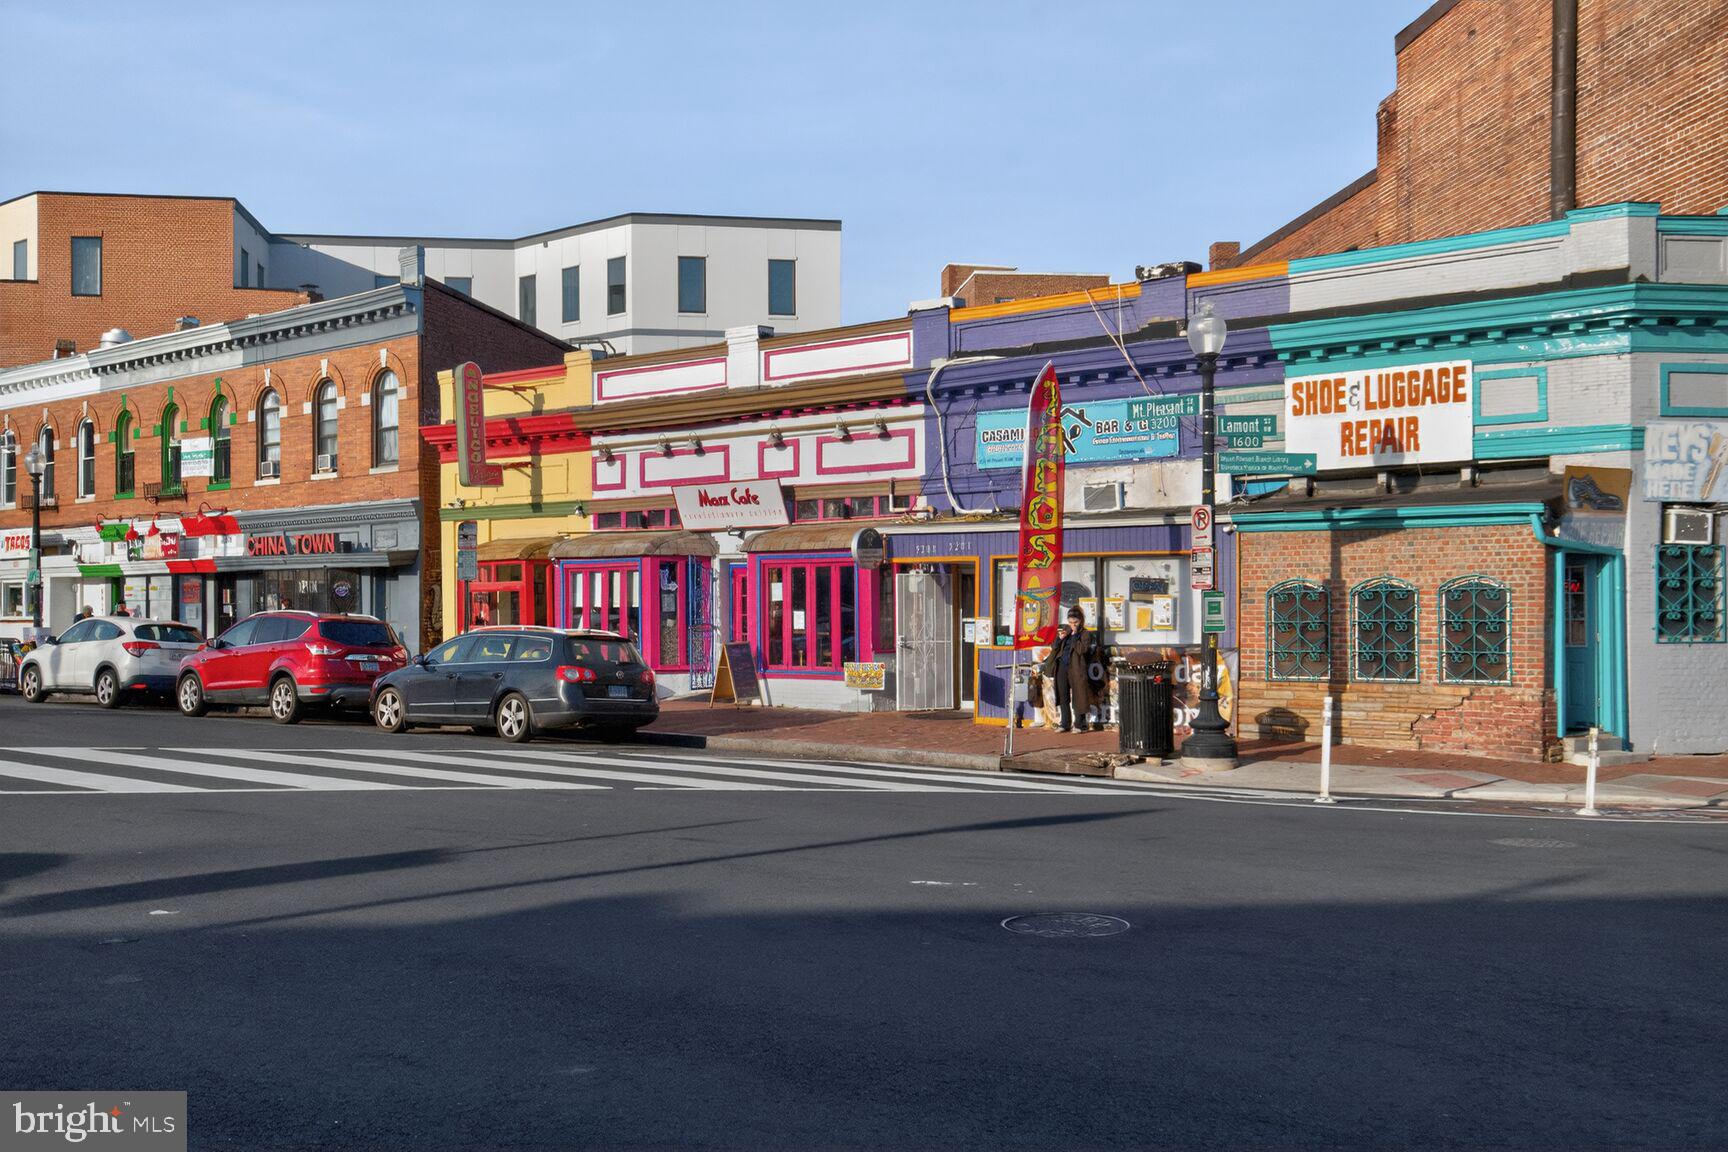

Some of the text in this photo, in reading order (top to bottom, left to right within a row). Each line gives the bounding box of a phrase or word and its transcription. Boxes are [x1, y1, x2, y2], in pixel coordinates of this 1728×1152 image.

[1292, 378, 1346, 416] SHOE
[1364, 366, 1467, 411] LUGGAGE
[1146, 399, 1184, 417] Pleasant
[982, 428, 1026, 443] CASAMI
[1095, 421, 1120, 434] BAR
[1151, 416, 1177, 430] 3200
[1220, 418, 1260, 433] Lamont
[1233, 437, 1259, 447] 1600
[1341, 416, 1420, 457] REPAIR
[698, 487, 760, 507] Marx Cafe
[4, 535, 30, 551] TACOS
[247, 532, 335, 557] CHINA TOWN
